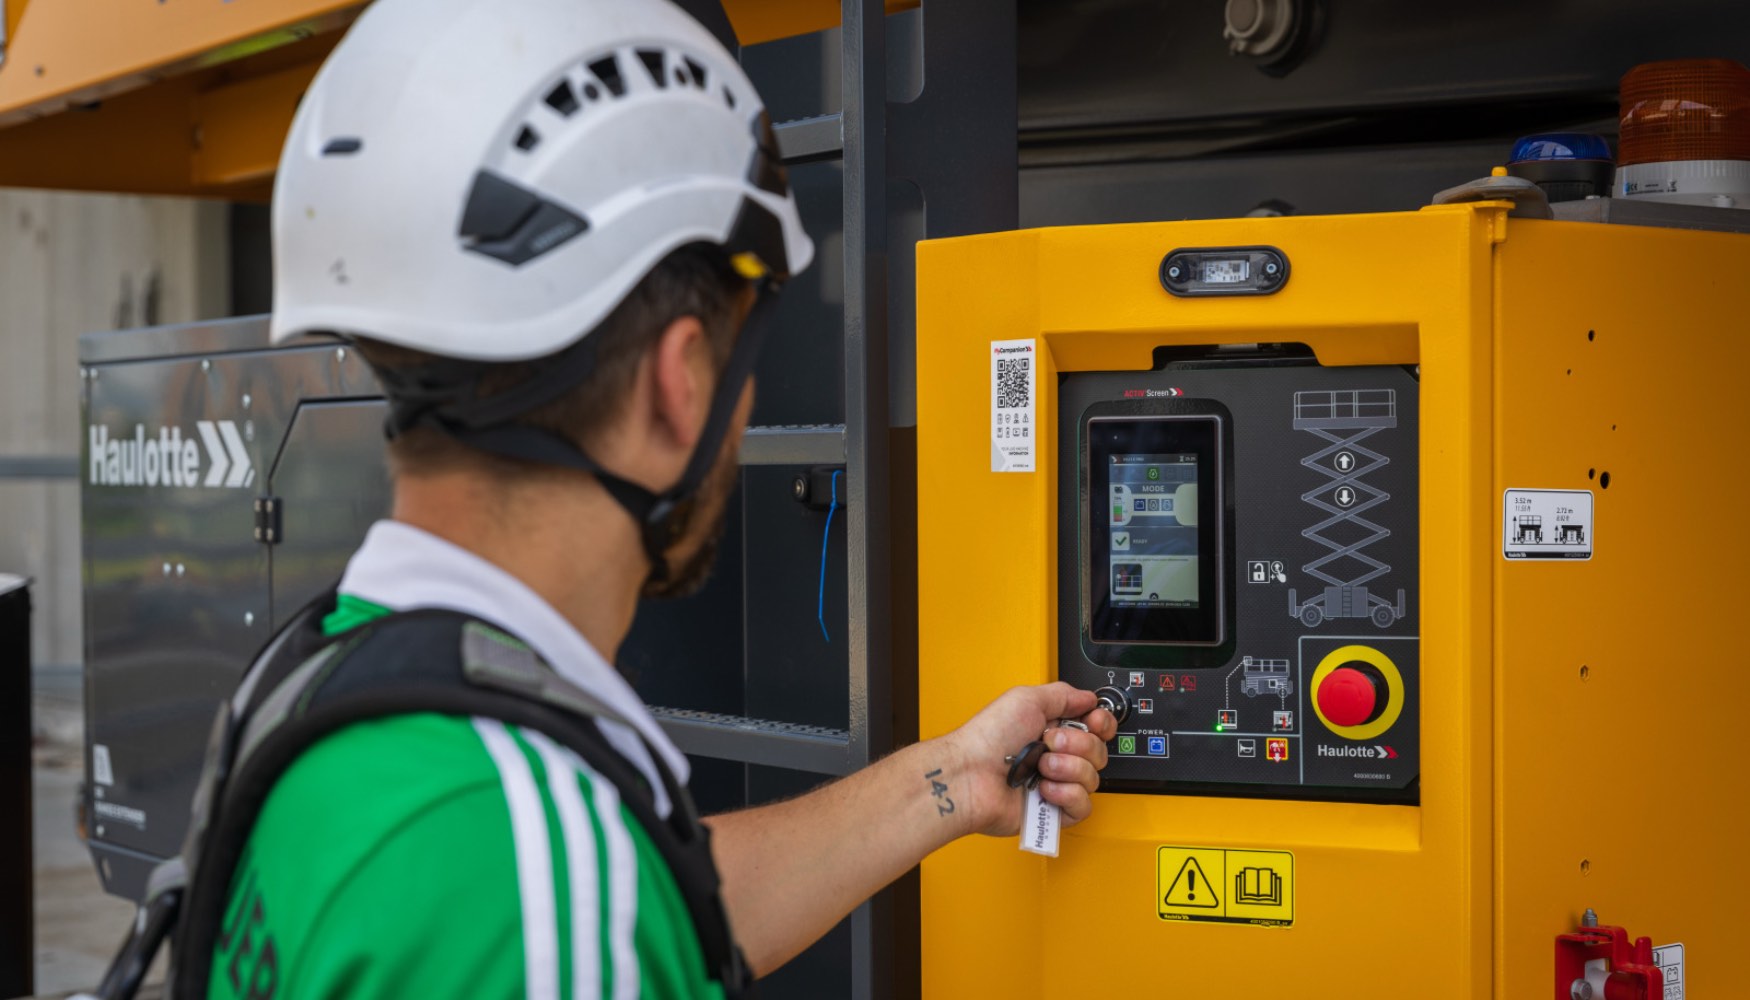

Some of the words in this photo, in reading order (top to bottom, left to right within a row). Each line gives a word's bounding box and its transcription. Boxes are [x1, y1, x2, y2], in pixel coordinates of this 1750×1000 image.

[89, 423, 200, 487] Haulotte
[1142, 485, 1165, 493] MODE
[1317, 745, 1375, 758] Haulotte
[925, 768, 955, 817] 142
[1035, 806, 1047, 848] Haulotte
